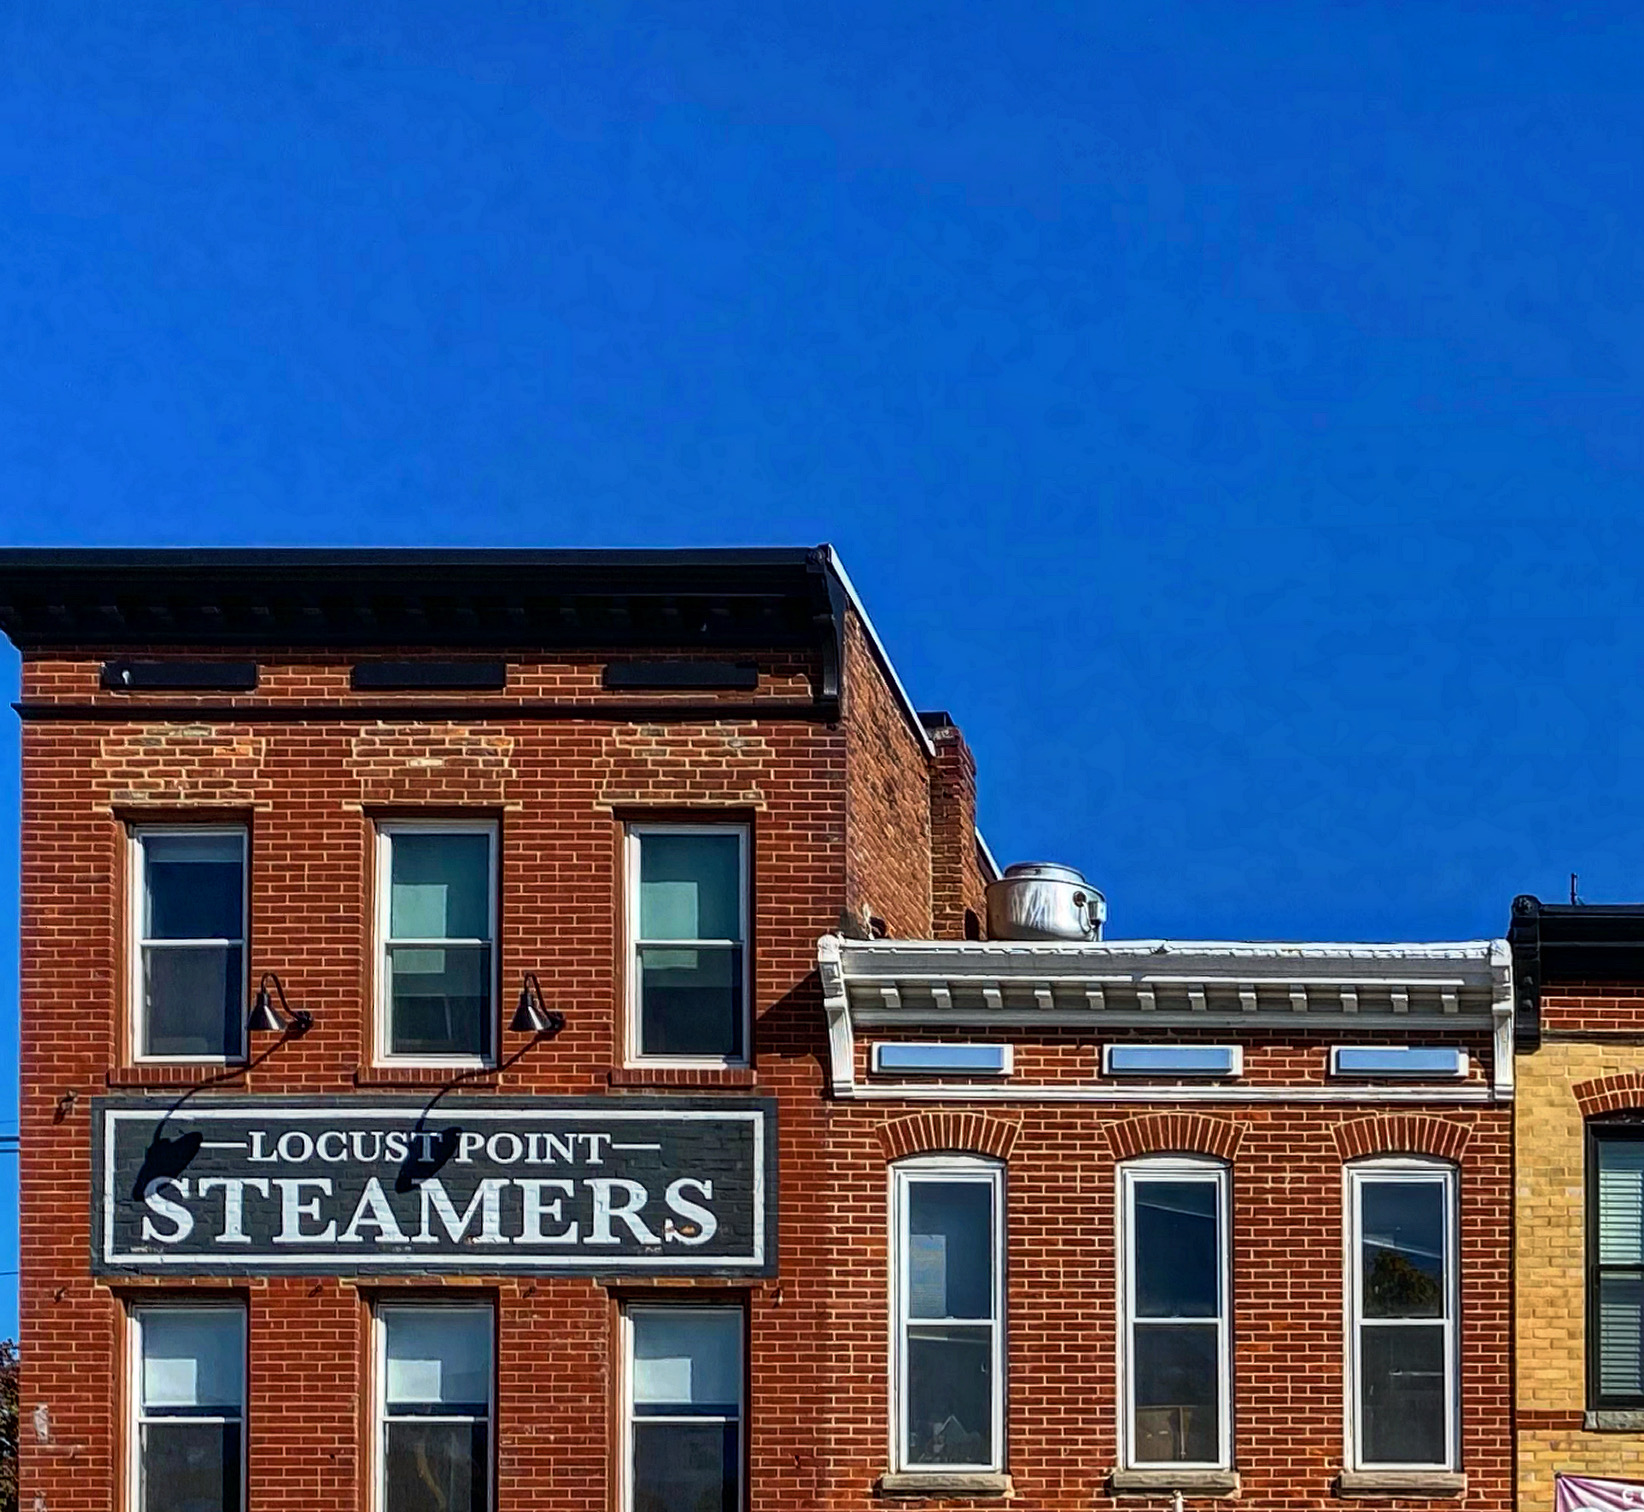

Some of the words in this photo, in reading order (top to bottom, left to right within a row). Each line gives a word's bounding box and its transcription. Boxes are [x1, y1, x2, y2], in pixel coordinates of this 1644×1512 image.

[247, 1130, 443, 1163] LOCUST
[454, 1132, 612, 1165] POINT
[142, 1176, 718, 1245] STEAMERS
